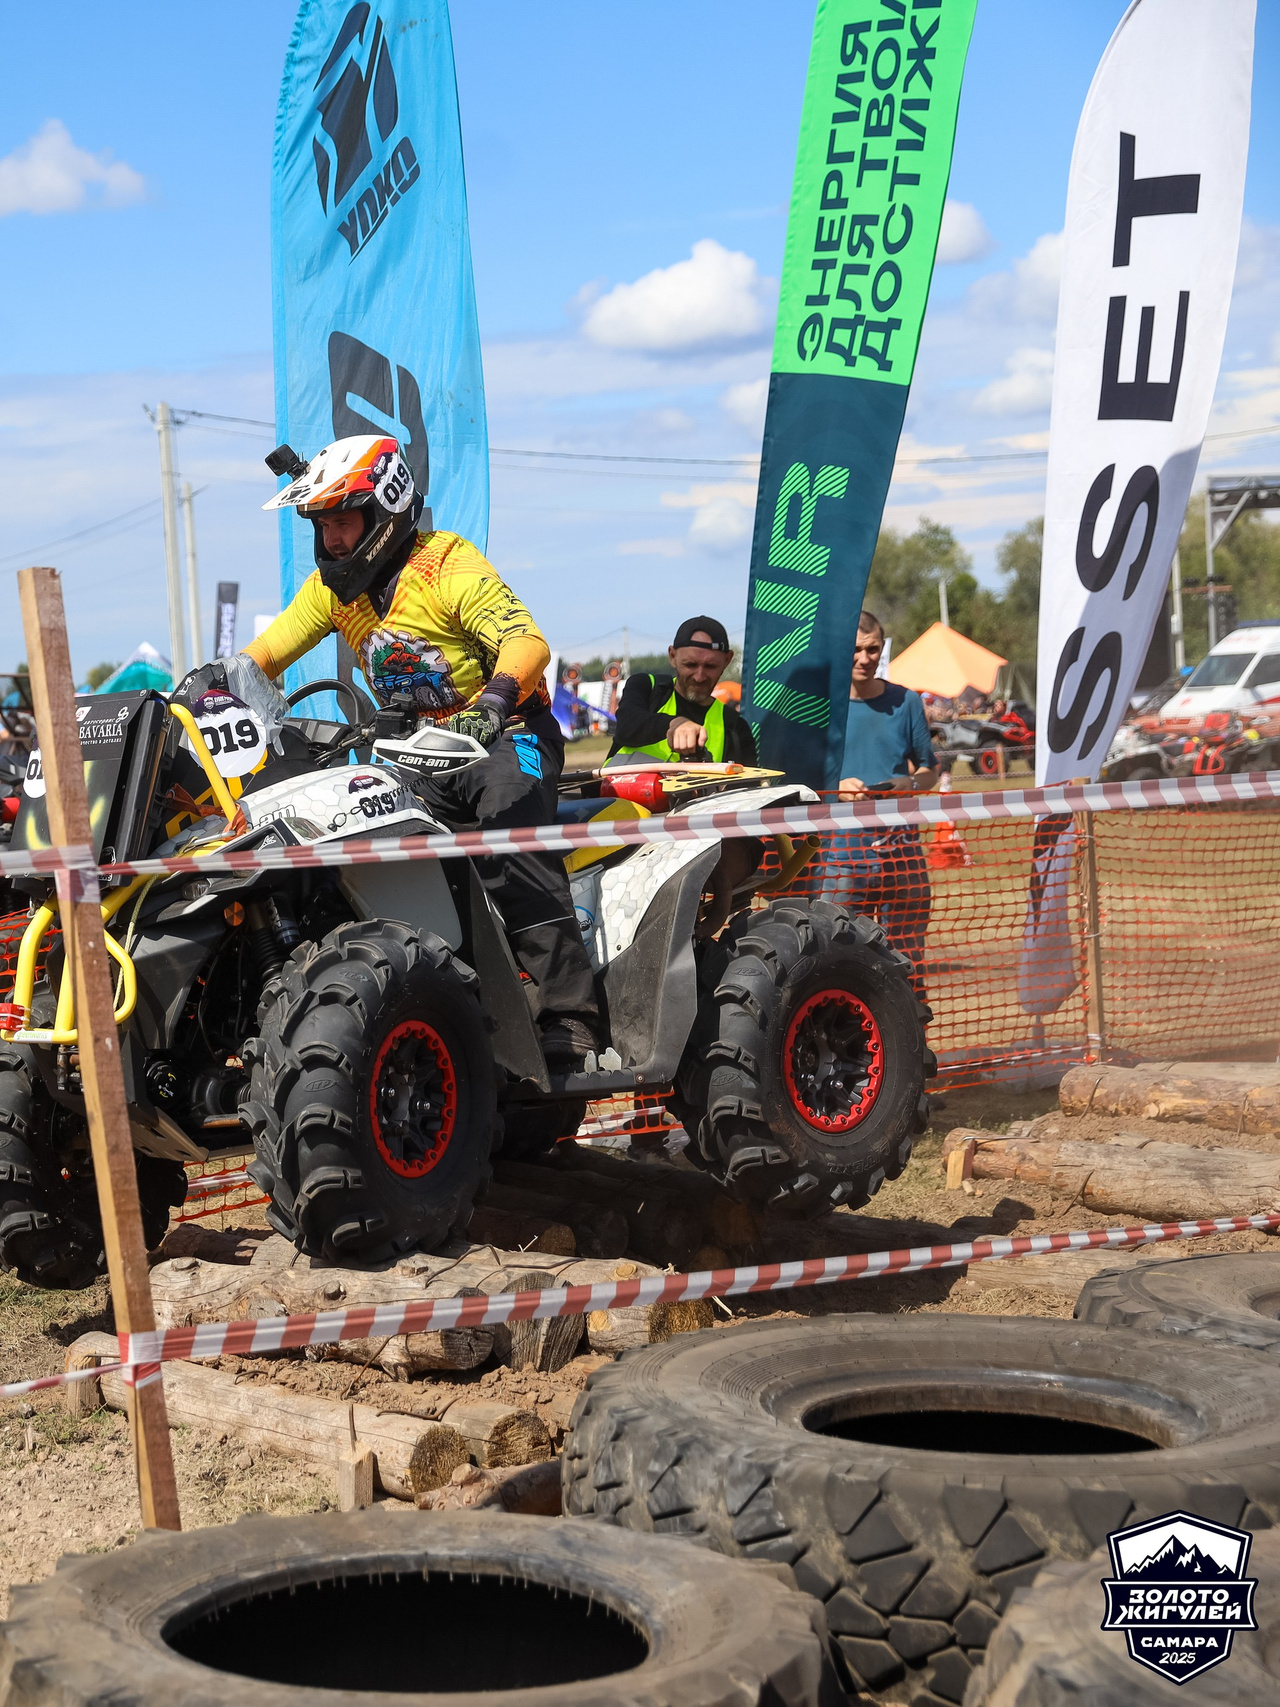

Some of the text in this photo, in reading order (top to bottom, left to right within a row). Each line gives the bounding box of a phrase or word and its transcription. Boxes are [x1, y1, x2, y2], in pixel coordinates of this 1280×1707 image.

[797, 20, 873, 362] ЭНЕРГИЯ
[858, 0, 943, 372] ДОСТИЖ
[825, 214, 880, 368] ДЛЯ
[383, 463, 410, 506] 019
[1038, 131, 1201, 880] SSET
[79, 722, 123, 739] BAVARIA
[200, 718, 260, 756] 019
[397, 753, 450, 768] can-am
[359, 793, 396, 818] 019
